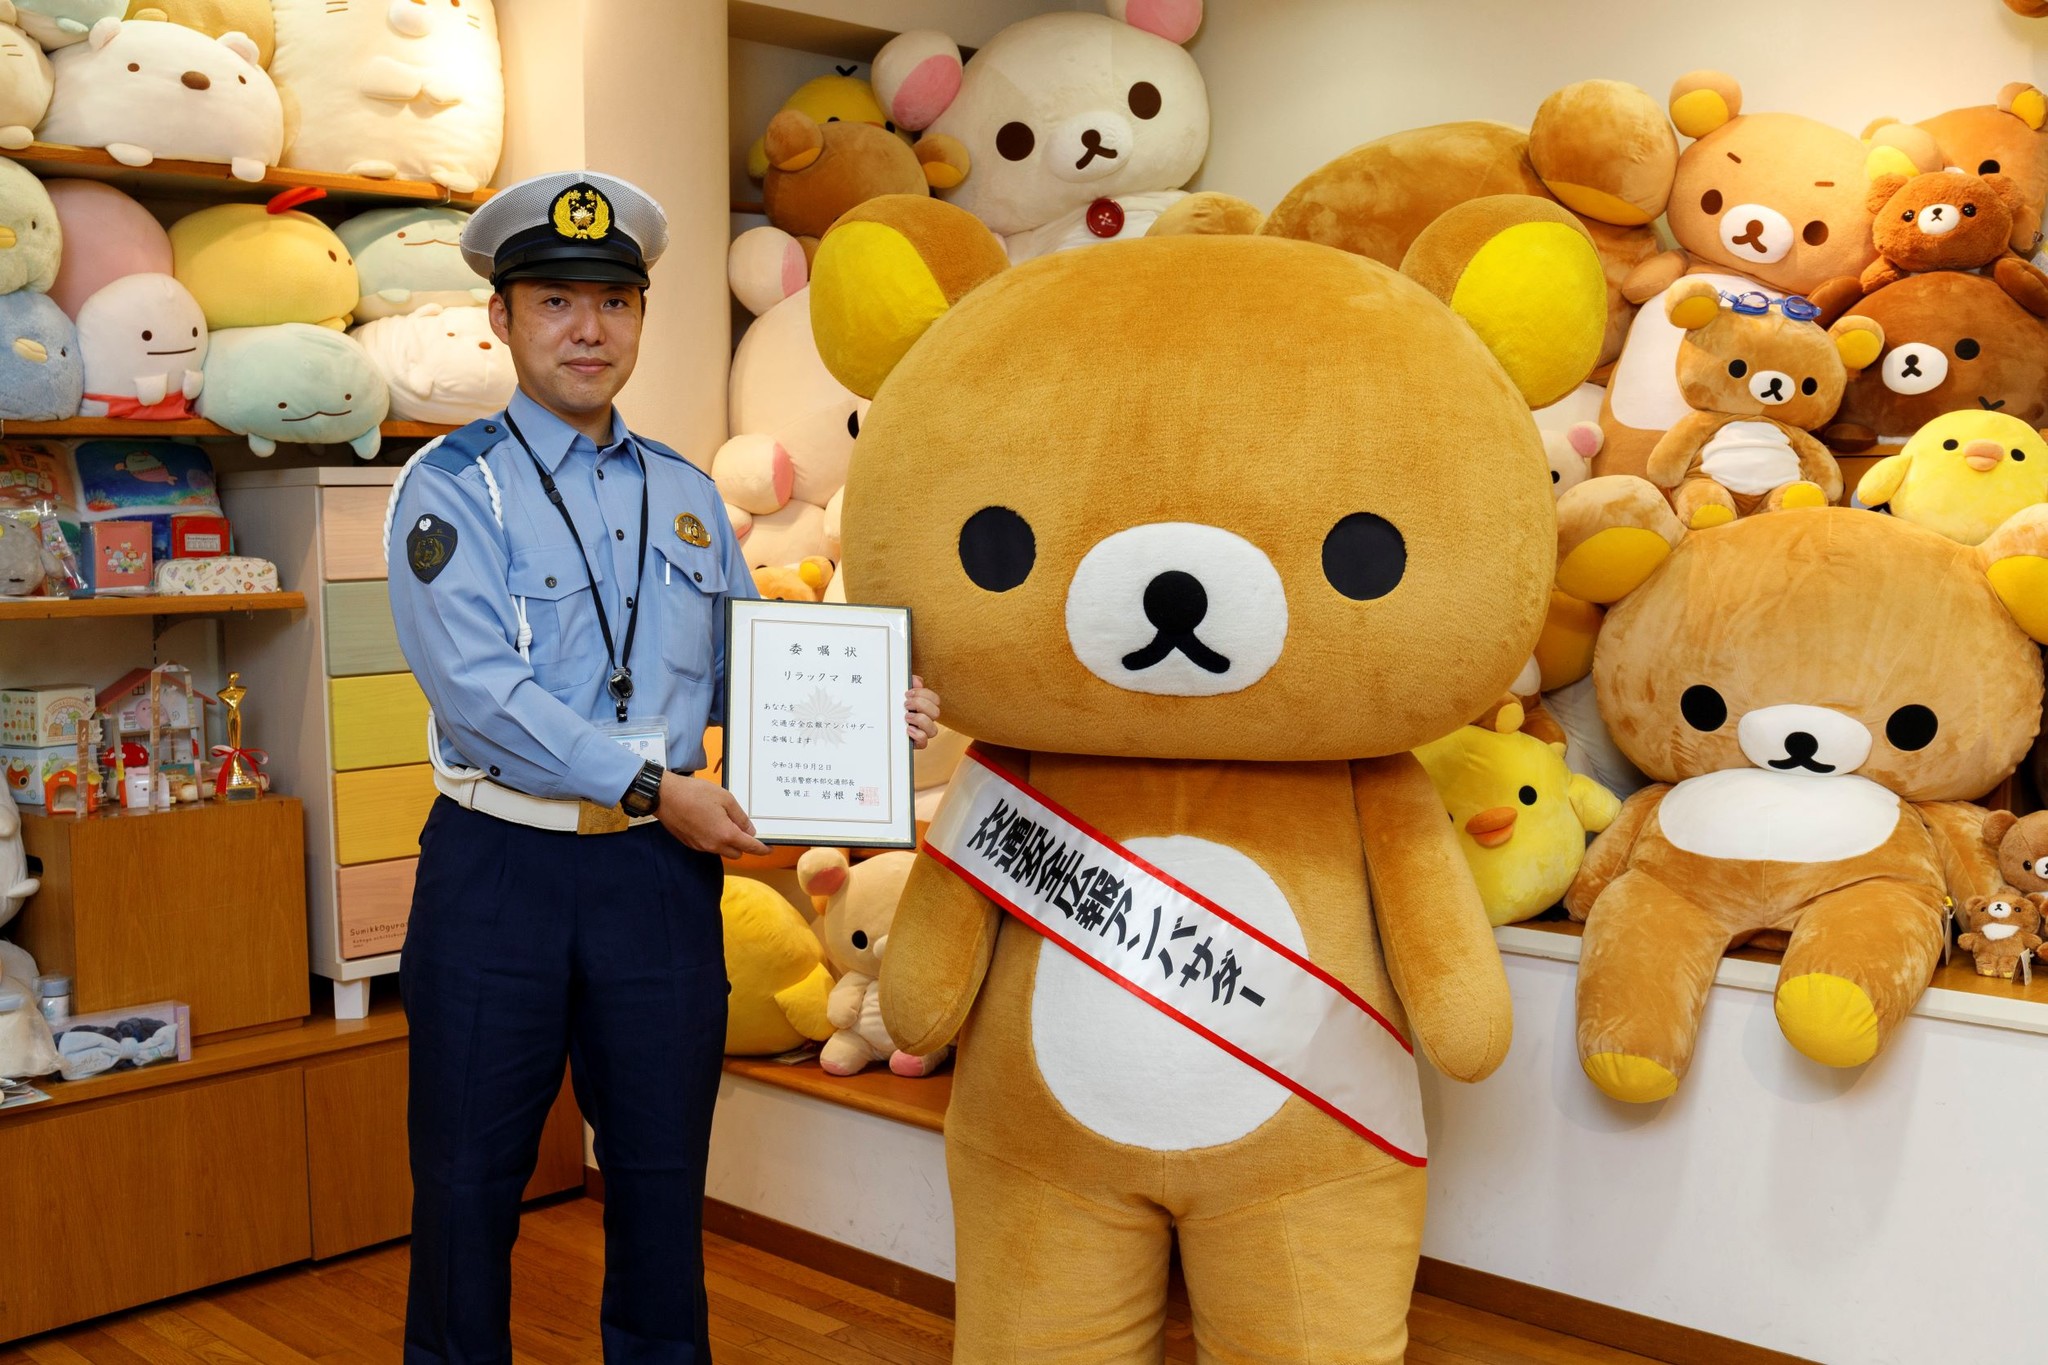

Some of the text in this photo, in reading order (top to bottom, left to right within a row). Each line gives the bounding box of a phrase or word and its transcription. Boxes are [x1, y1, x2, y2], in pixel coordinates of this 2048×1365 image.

[784, 670, 863, 684] リラックマ 殿
[764, 703, 796, 712] あなたを
[771, 719, 875, 730] 交通安全広報アンバサダー
[966, 799, 1266, 1008] 交通安全広報アンバサダー
